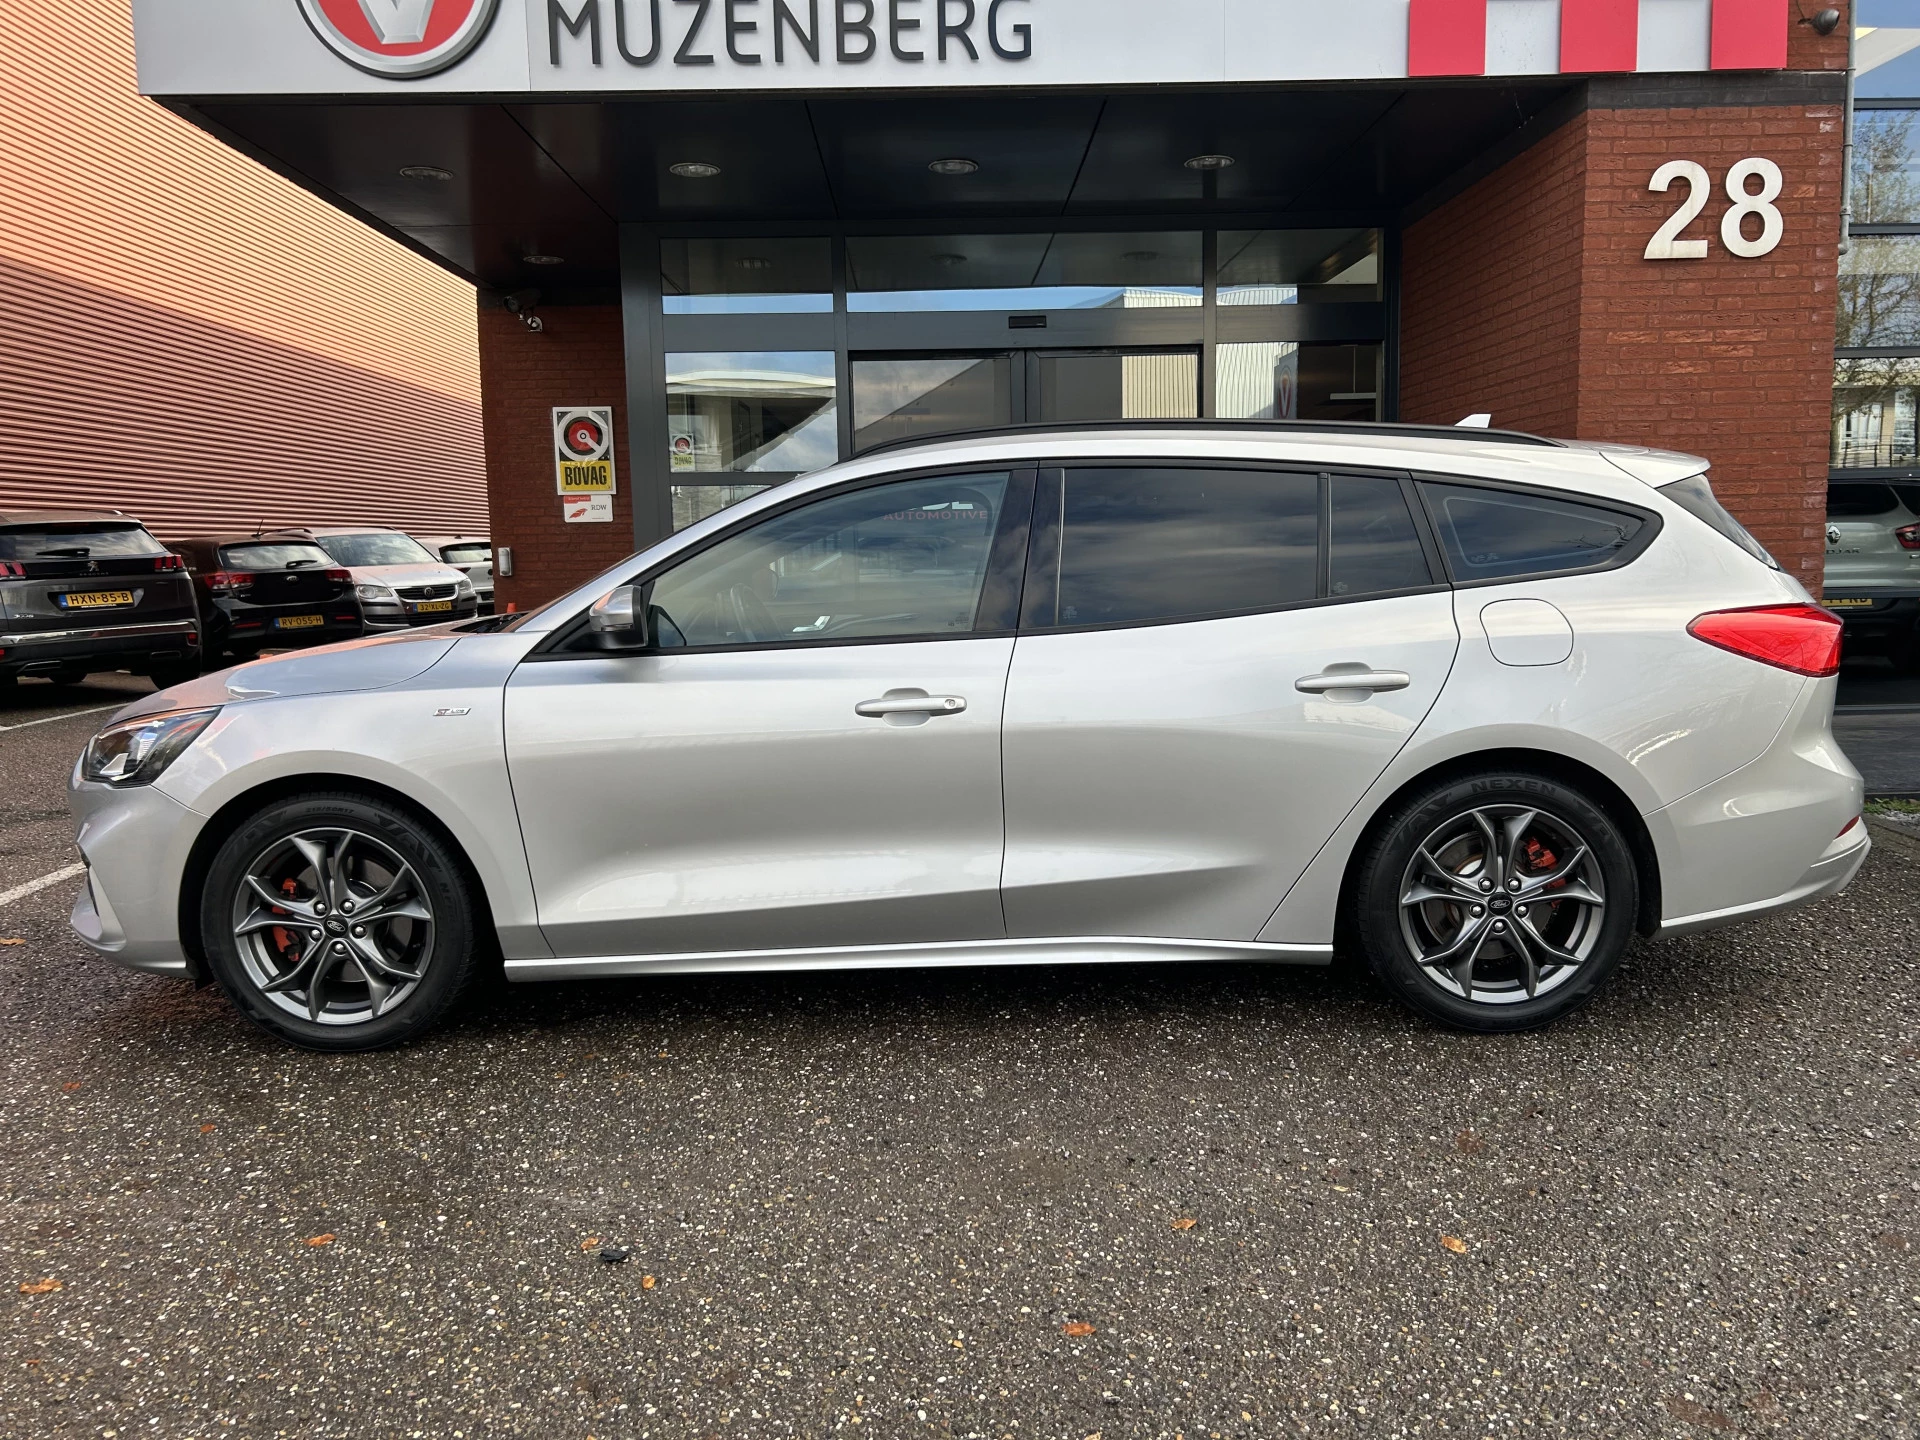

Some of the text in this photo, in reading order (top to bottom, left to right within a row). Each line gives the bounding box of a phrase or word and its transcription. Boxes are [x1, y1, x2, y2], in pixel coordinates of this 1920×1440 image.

[546, 0, 1032, 65] MUZENBERG
[1643, 157, 1784, 260] 28
[564, 465, 608, 486] BOVAG
[883, 510, 988, 521] AUTOMOTIVE
[69, 592, 130, 605] HXN-85-B
[281, 616, 322, 626] RV-055-H
[1470, 778, 1556, 796] NEXEN
